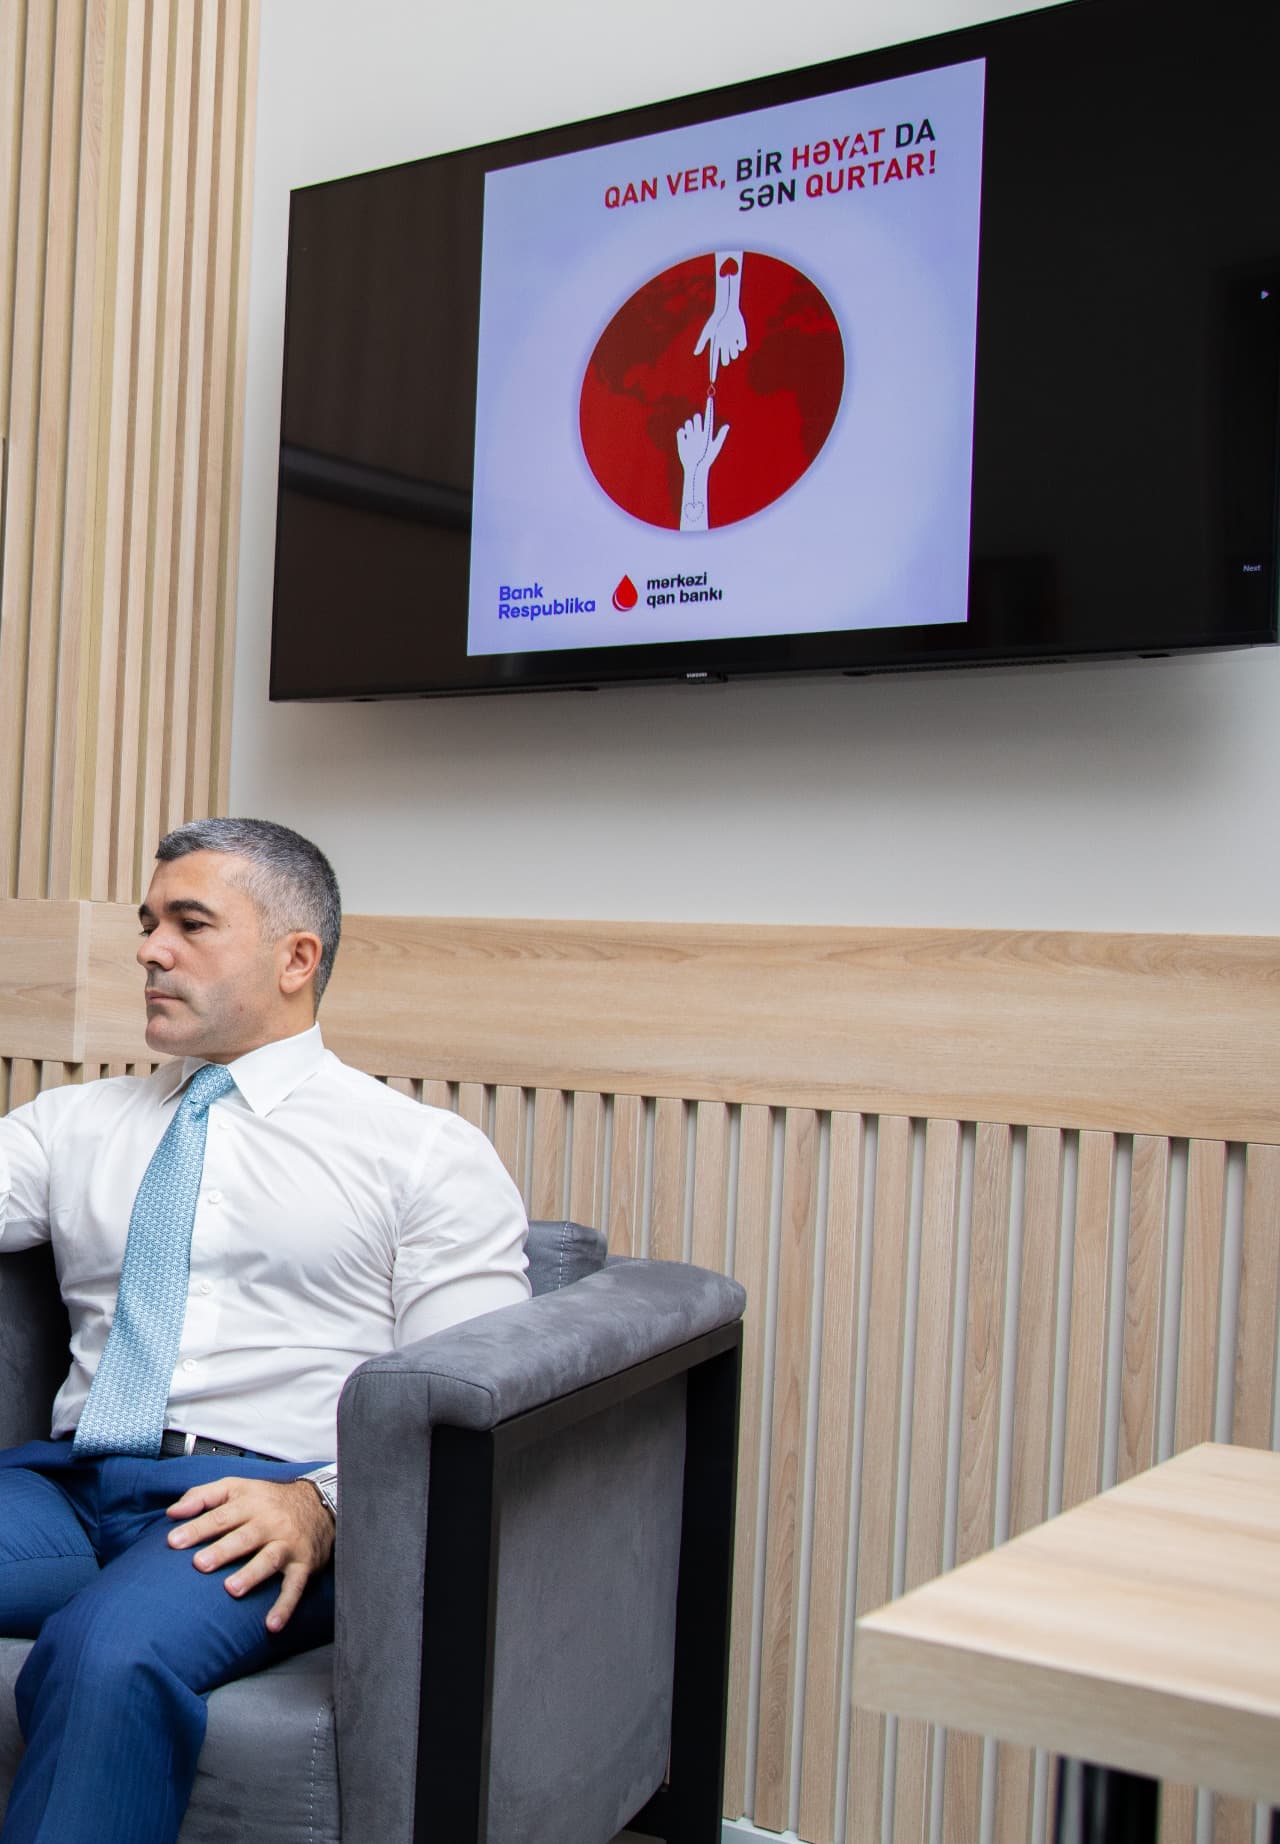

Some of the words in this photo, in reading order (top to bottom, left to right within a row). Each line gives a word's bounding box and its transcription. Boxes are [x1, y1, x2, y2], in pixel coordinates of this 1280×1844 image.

[604, 177, 658, 209] QAN
[666, 165, 727, 197] VER,
[736, 149, 783, 182] BİR
[792, 128, 886, 171] HƏYAT
[895, 118, 936, 149] DA
[739, 179, 796, 212] SƏN
[805, 150, 936, 198] QURTAR!
[646, 571, 707, 590] mərkəzi
[499, 582, 543, 601] Bank
[646, 593, 675, 609] qan
[498, 597, 596, 621] Respublika
